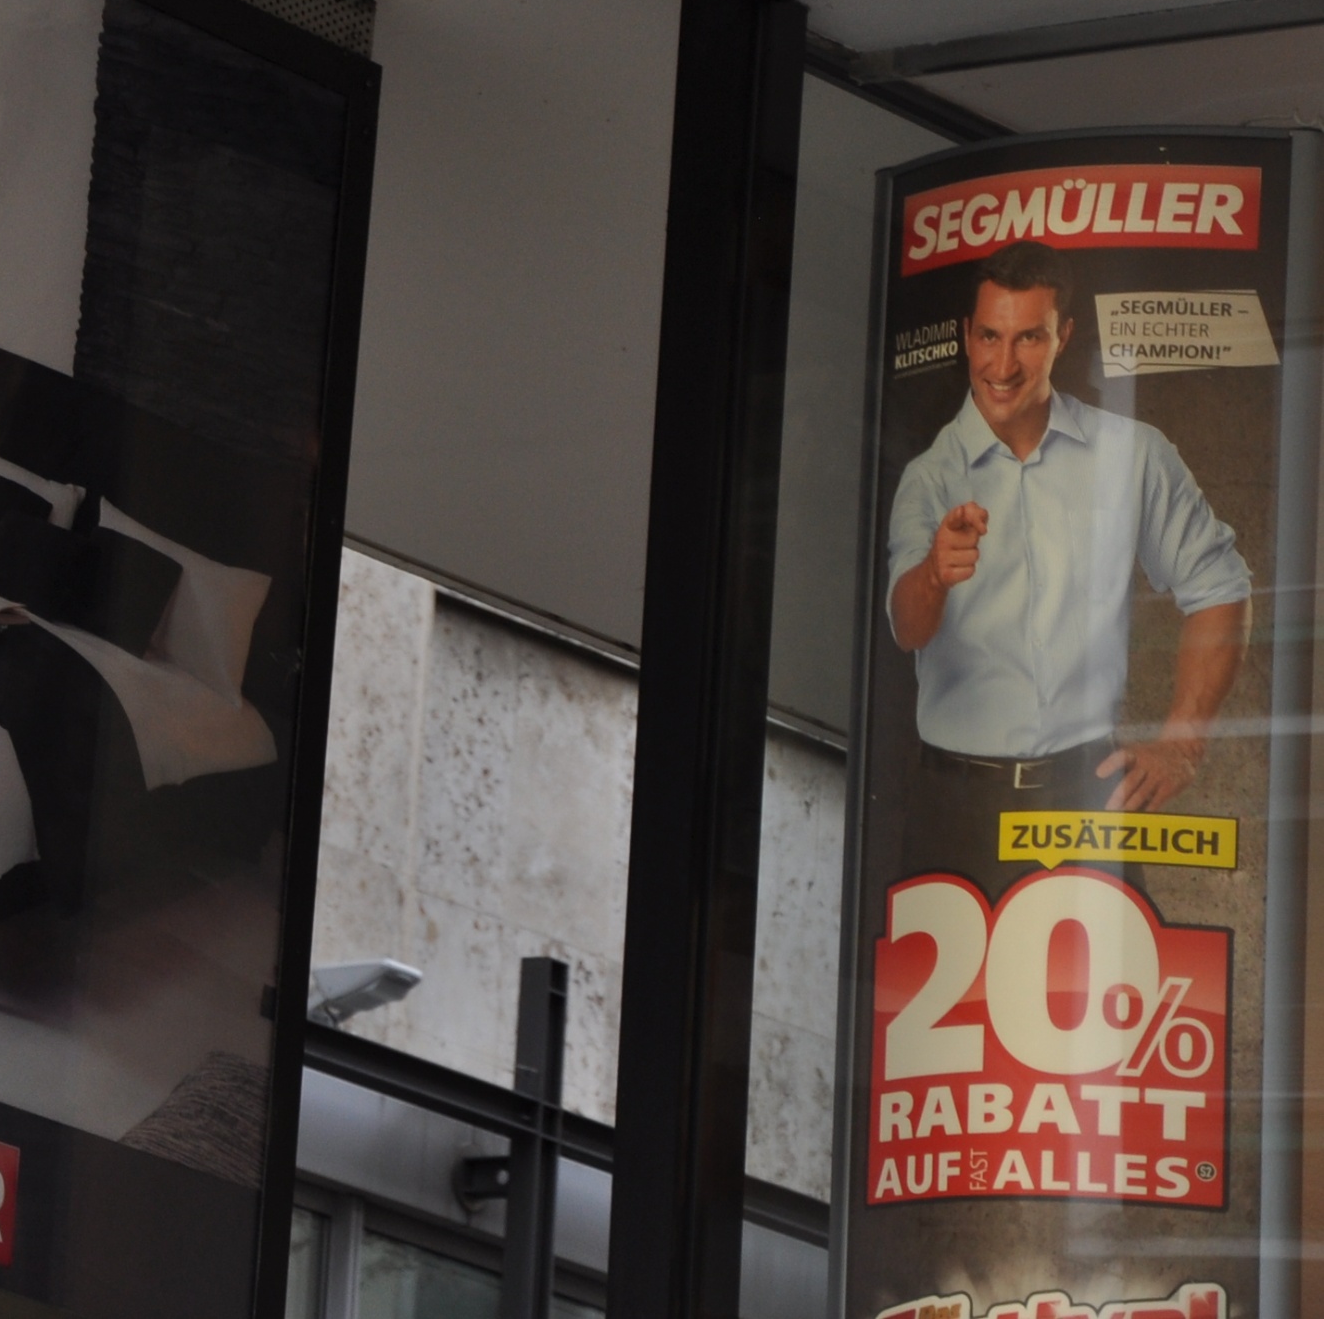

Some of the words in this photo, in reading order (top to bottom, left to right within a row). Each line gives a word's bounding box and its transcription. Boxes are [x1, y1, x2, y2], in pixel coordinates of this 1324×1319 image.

[907, 177, 1244, 261] SEGMÜLLER
[895, 319, 958, 351] WLADIMIR
[1110, 322, 1137, 337] EIN
[1142, 322, 1210, 338] ECHTER
[894, 340, 959, 371] KLITSCHKO
[1011, 818, 1220, 856] ZUSÄTZLICH
[879, 1082, 1207, 1143] RABATT
[874, 1151, 962, 1199] AUF
[969, 1148, 988, 1192] FAST
[992, 1149, 1191, 1199] ALLES
